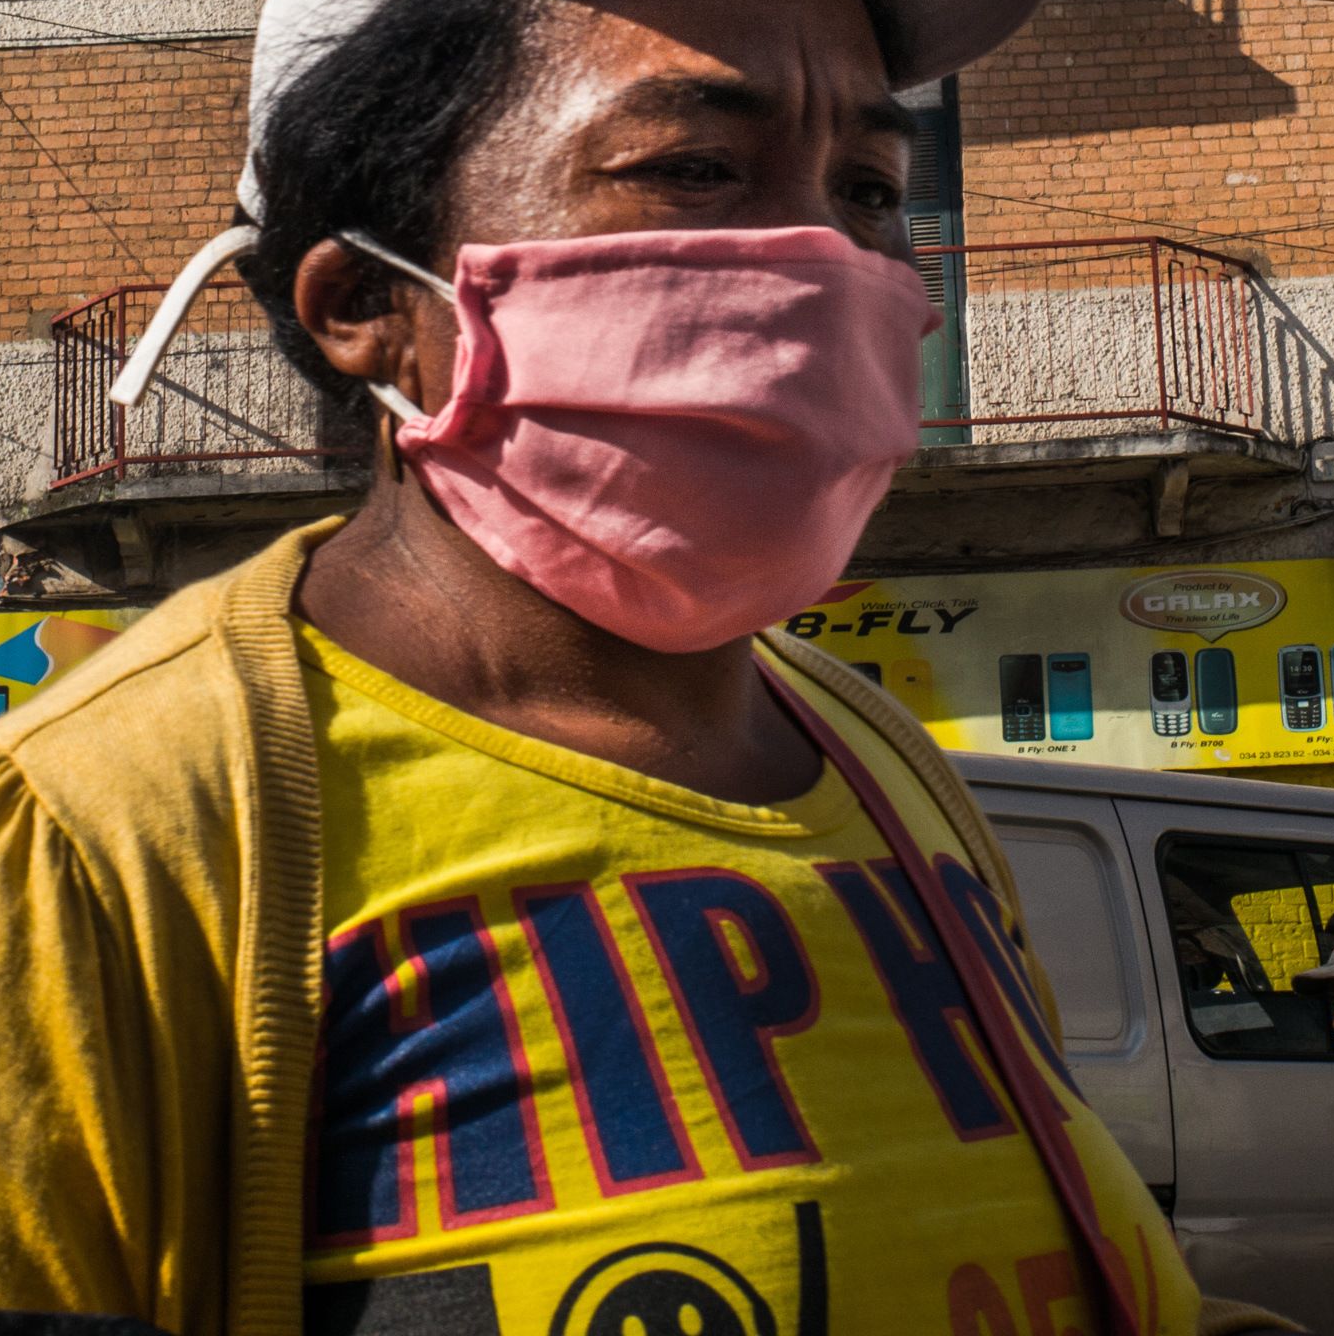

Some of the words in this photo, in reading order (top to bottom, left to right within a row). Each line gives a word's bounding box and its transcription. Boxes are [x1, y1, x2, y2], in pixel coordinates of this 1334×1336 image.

[1173, 583, 1216, 592] Product
[1218, 582, 1233, 591] by
[1143, 592, 1260, 612] GALAX
[785, 607, 980, 640] B-FLY
[1047, 745, 1069, 753] ONE
[1200, 740, 1224, 748] B700
[1239, 752, 1257, 760] 034
[1259, 751, 1271, 759] 23
[1273, 750, 1291, 759] 823
[1293, 750, 1305, 758] 82
[1313, 749, 1331, 757] 034
[302, 867, 823, 1246] HIP
